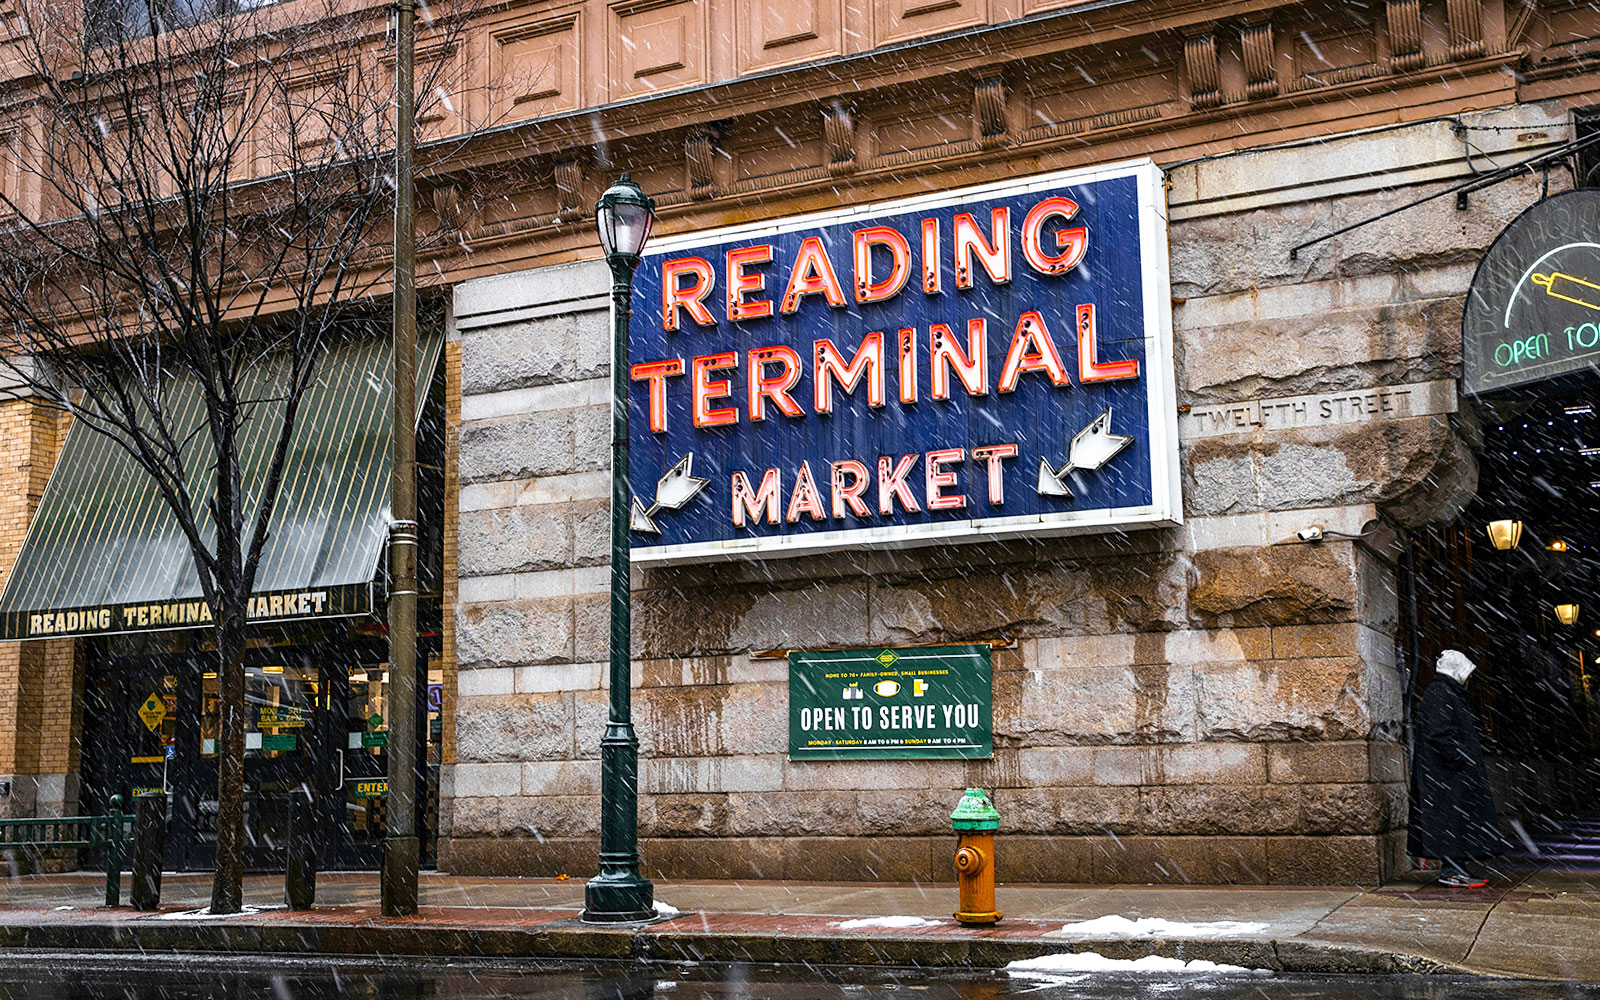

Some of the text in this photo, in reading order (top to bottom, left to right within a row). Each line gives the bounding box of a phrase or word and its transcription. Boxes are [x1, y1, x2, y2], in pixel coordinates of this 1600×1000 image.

[662, 196, 1089, 332] READING
[1494, 321, 1600, 367] OPEN TO
[630, 303, 1141, 433] TERMINAL
[1192, 391, 1412, 432] TWELFTH STREET
[731, 443, 1019, 529] MARKET
[30, 609, 110, 635] READING
[123, 601, 213, 627] TERMINA
[801, 703, 979, 731] OPEN TO SERVE YOU
[357, 782, 388, 792] ENTER
